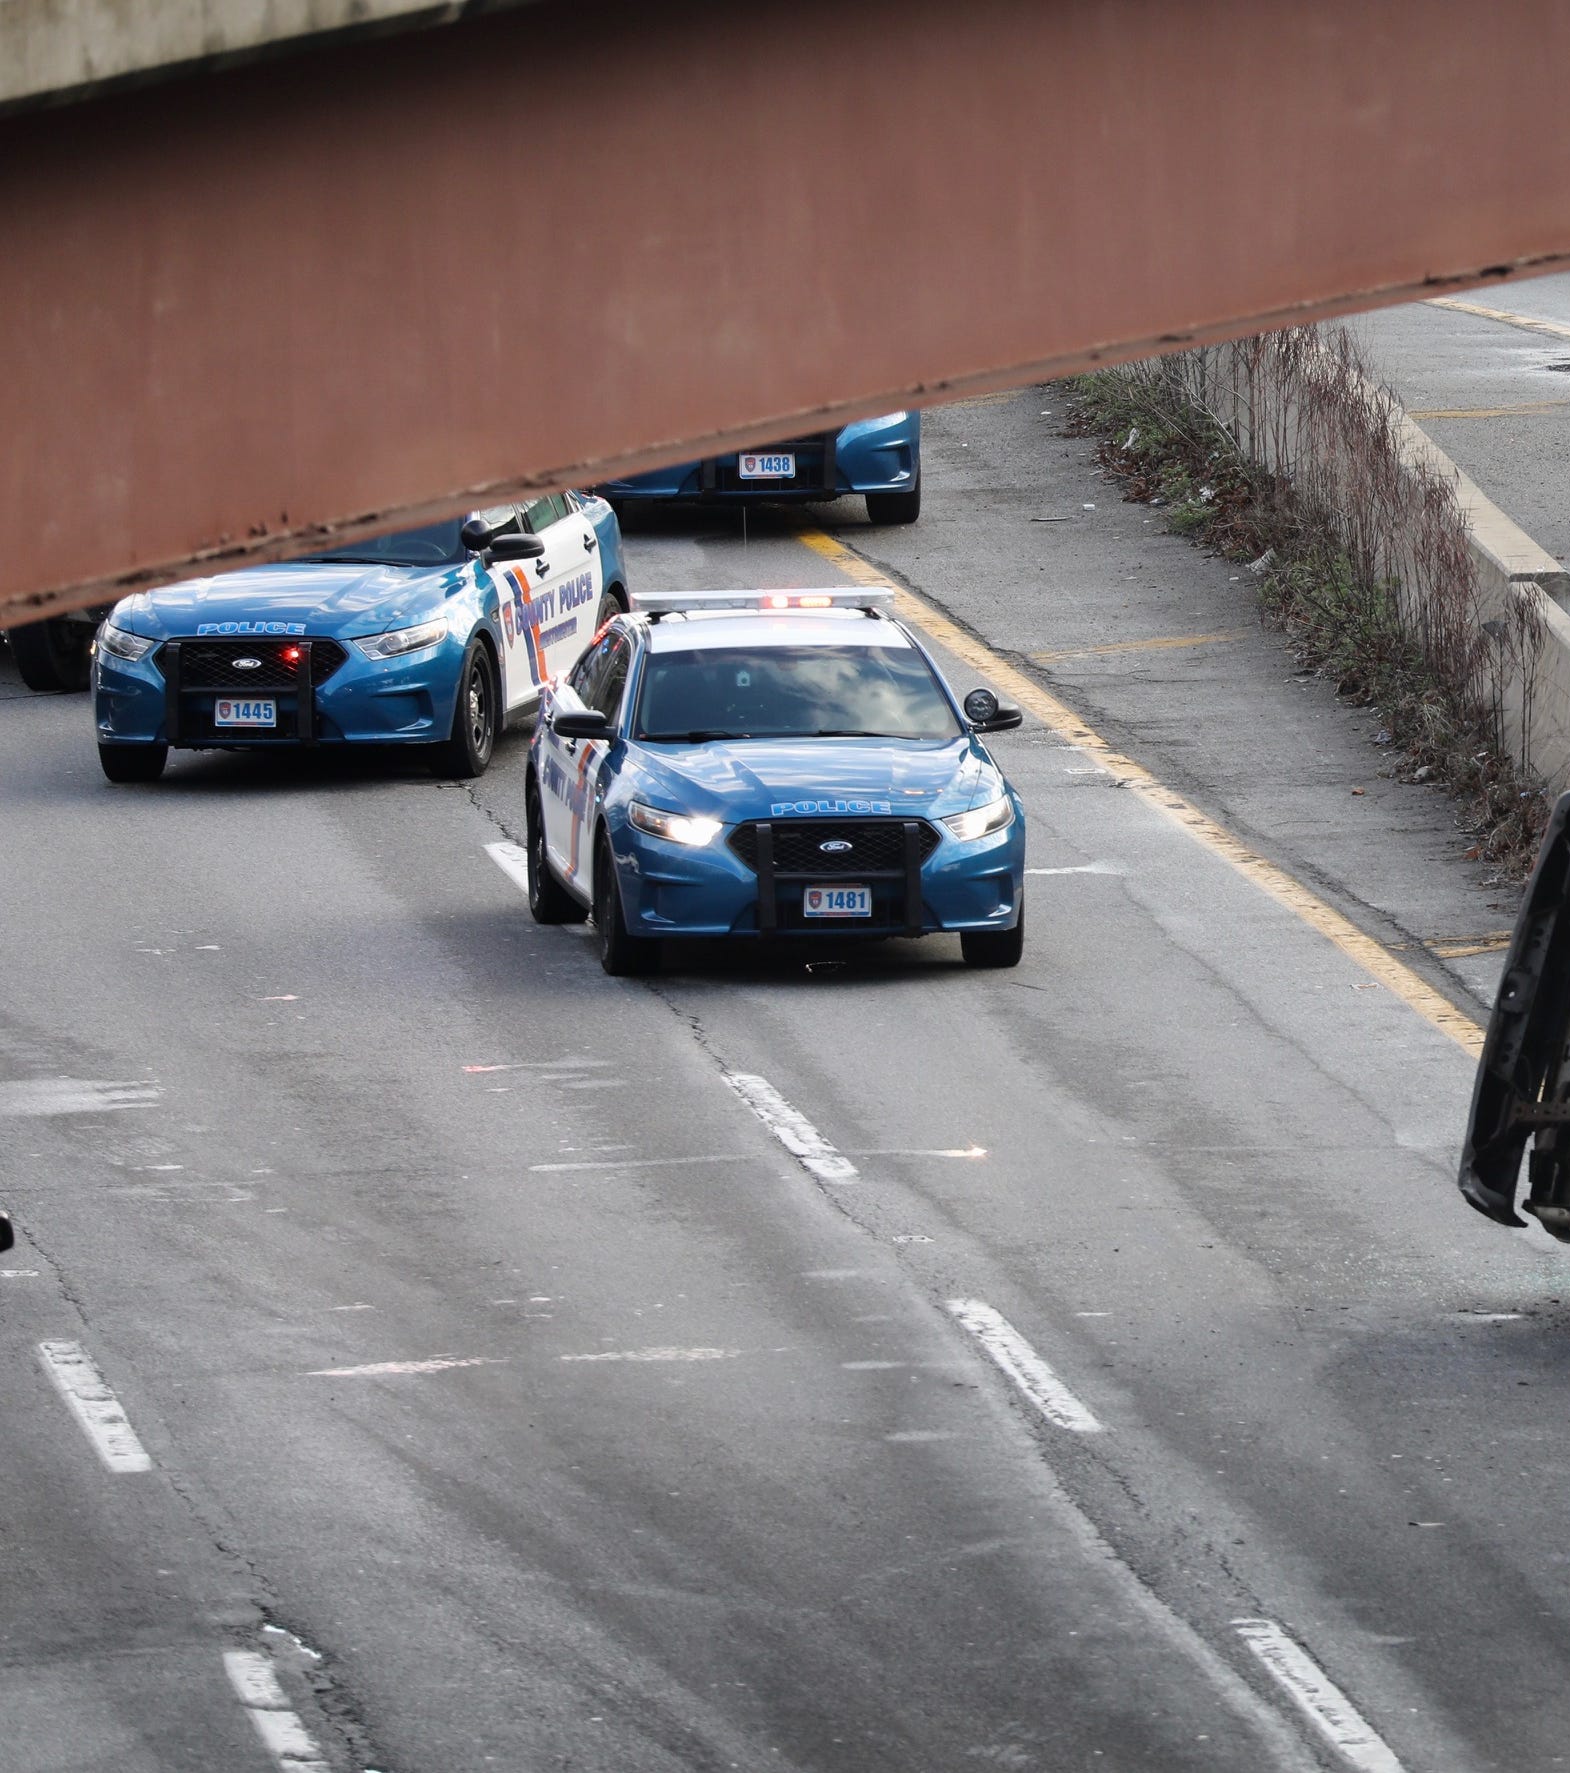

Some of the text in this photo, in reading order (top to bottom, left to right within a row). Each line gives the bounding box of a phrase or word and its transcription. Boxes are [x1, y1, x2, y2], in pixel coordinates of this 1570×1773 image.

[758, 456, 790, 472] 1438
[515, 589, 555, 635] COUNTY
[559, 571, 593, 614] POLICE
[197, 621, 306, 636] POLICE
[233, 702, 273, 719] 1445
[771, 800, 892, 816] POLICE
[826, 891, 866, 909] 1481
